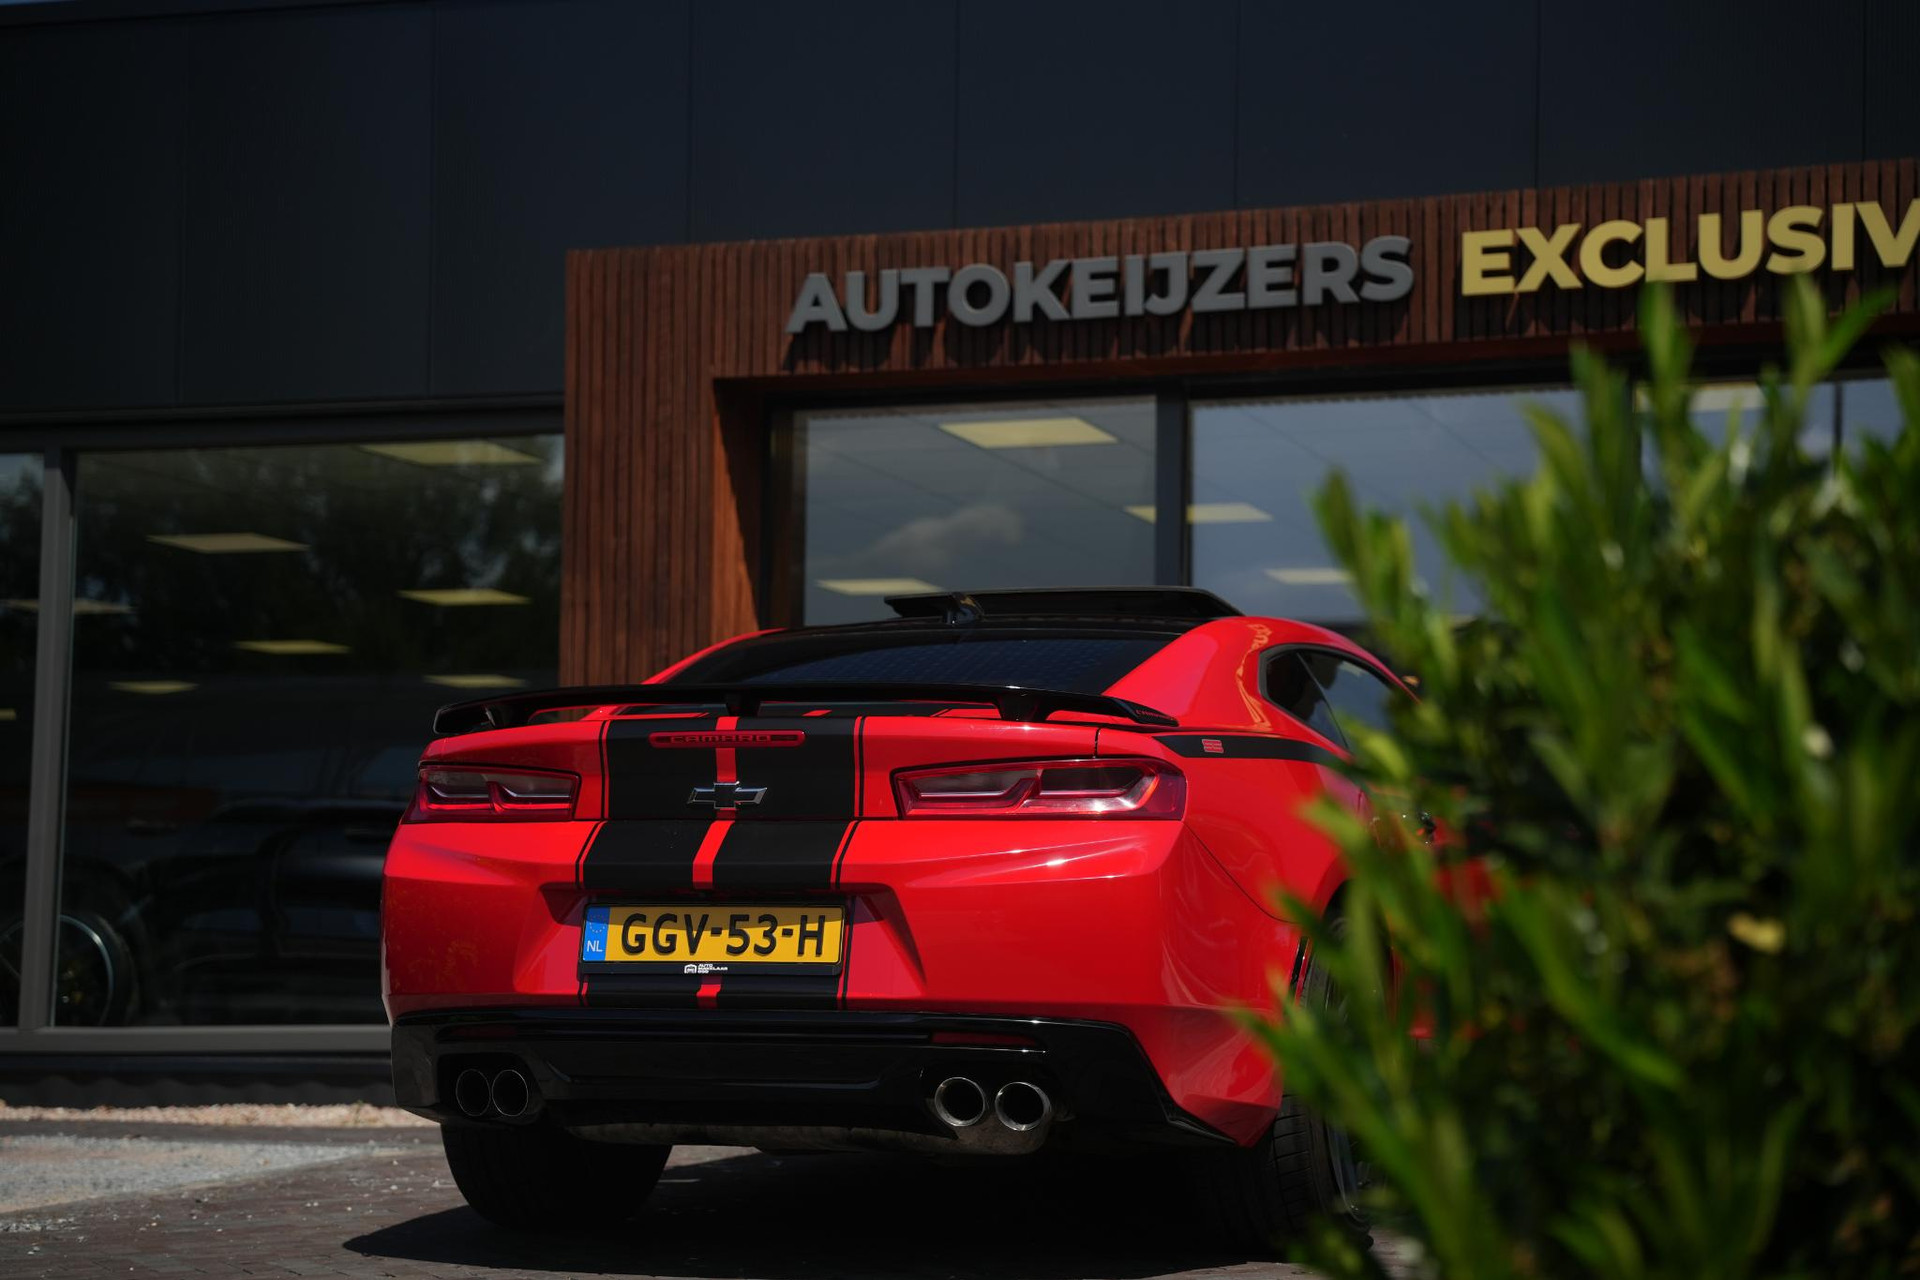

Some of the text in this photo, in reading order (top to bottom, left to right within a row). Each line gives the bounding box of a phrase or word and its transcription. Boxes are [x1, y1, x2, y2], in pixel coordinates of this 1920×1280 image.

[785, 198, 1920, 333] AUTOKEIJZERS EXCLUSIV
[586, 939, 603, 953] NL
[621, 913, 826, 956] GGV-53-H
